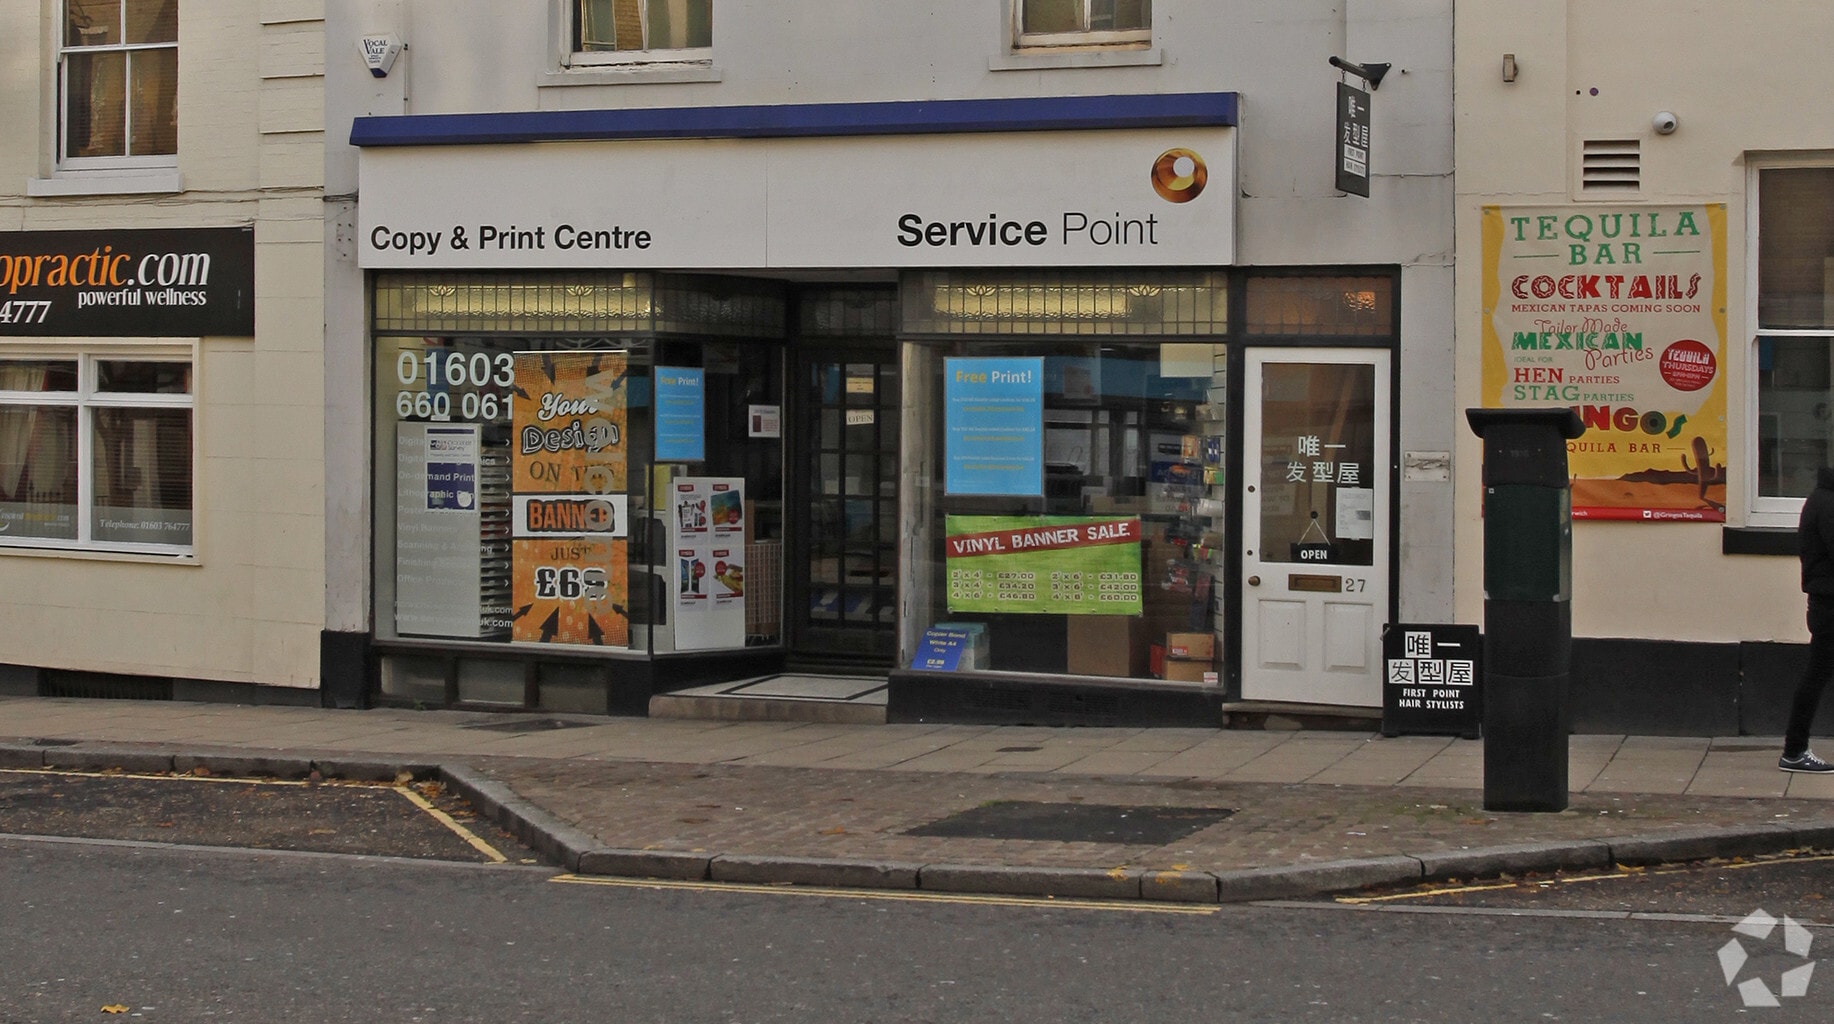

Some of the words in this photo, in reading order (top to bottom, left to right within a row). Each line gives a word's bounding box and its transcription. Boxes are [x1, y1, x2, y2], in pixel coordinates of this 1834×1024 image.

[1348, 95, 1365, 118] 唯一
[1344, 121, 1368, 148] 发型屋
[897, 213, 1048, 247] Service
[1063, 212, 1159, 246] Point
[1510, 211, 1700, 242] TEQUILA
[370, 226, 442, 255] Copy
[450, 226, 469, 249] &
[479, 226, 545, 249] Print
[554, 224, 652, 250] Centre
[1568, 242, 1642, 266] BAR
[1511, 273, 1702, 300] COCKTAILS
[78, 288, 141, 309] powerful
[146, 288, 207, 306] wellness
[0, 300, 52, 324] 4777
[1511, 304, 1566, 313] MEXICAN
[1570, 304, 1608, 313] TAPAS
[1611, 304, 1662, 313] COMING
[1666, 304, 1700, 313] SOON
[1534, 319, 1578, 335] Tailor
[1582, 317, 1628, 333] Made
[1511, 332, 1643, 350] MEXICAN
[1584, 347, 1654, 371] Parties
[1668, 349, 1709, 365] TEQUILA
[397, 351, 515, 387] 01603
[956, 370, 987, 383] Free
[991, 370, 1032, 383] Print!
[1514, 368, 1564, 384] HEN
[1569, 376, 1620, 384] PARTIES
[678, 377, 698, 386] Print!
[1514, 385, 1580, 401] STAG
[1583, 393, 1634, 402] PARTIES
[396, 391, 450, 418] 660
[462, 392, 513, 419] 061
[848, 415, 873, 423] OPEN
[1298, 435, 1346, 457] 唯一
[1629, 443, 1661, 453] BAR
[453, 472, 475, 482] Print
[530, 461, 561, 481] ON
[1286, 461, 1360, 484] 发型屋
[953, 537, 1005, 554] VINYL
[1011, 528, 1080, 549] BANNER
[1086, 523, 1130, 540] SALE
[1301, 550, 1328, 560] OPEN
[998, 572, 1035, 580] £27.00
[998, 582, 1035, 590] £34.20
[1100, 583, 1137, 591] £42.00
[1345, 578, 1366, 593] 27
[998, 592, 1035, 601] £46.80
[1406, 634, 1461, 656] 唯一
[1390, 660, 1472, 684] 发型屋
[1403, 688, 1426, 697] FIRST
[1433, 689, 1460, 698] POINT
[1399, 699, 1421, 708] HAIR
[1426, 700, 1464, 709] STYLISTS
